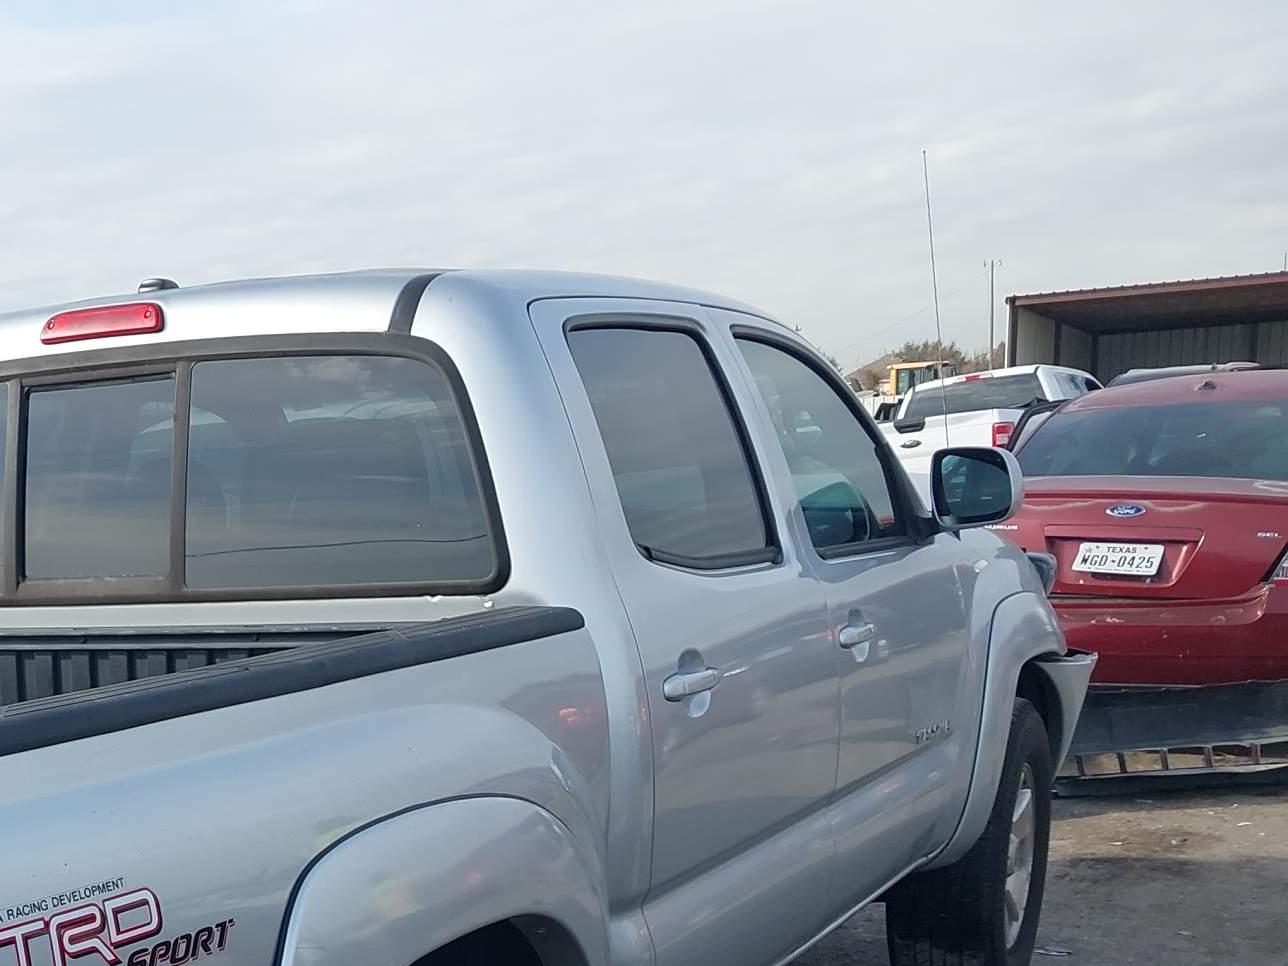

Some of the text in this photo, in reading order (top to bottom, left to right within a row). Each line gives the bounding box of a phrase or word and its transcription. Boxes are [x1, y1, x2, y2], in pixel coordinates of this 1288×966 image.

[1106, 546, 1138, 554] TEXAS
[6, 899, 50, 921] RACING
[51, 877, 126, 909] DEVELOPMENT
